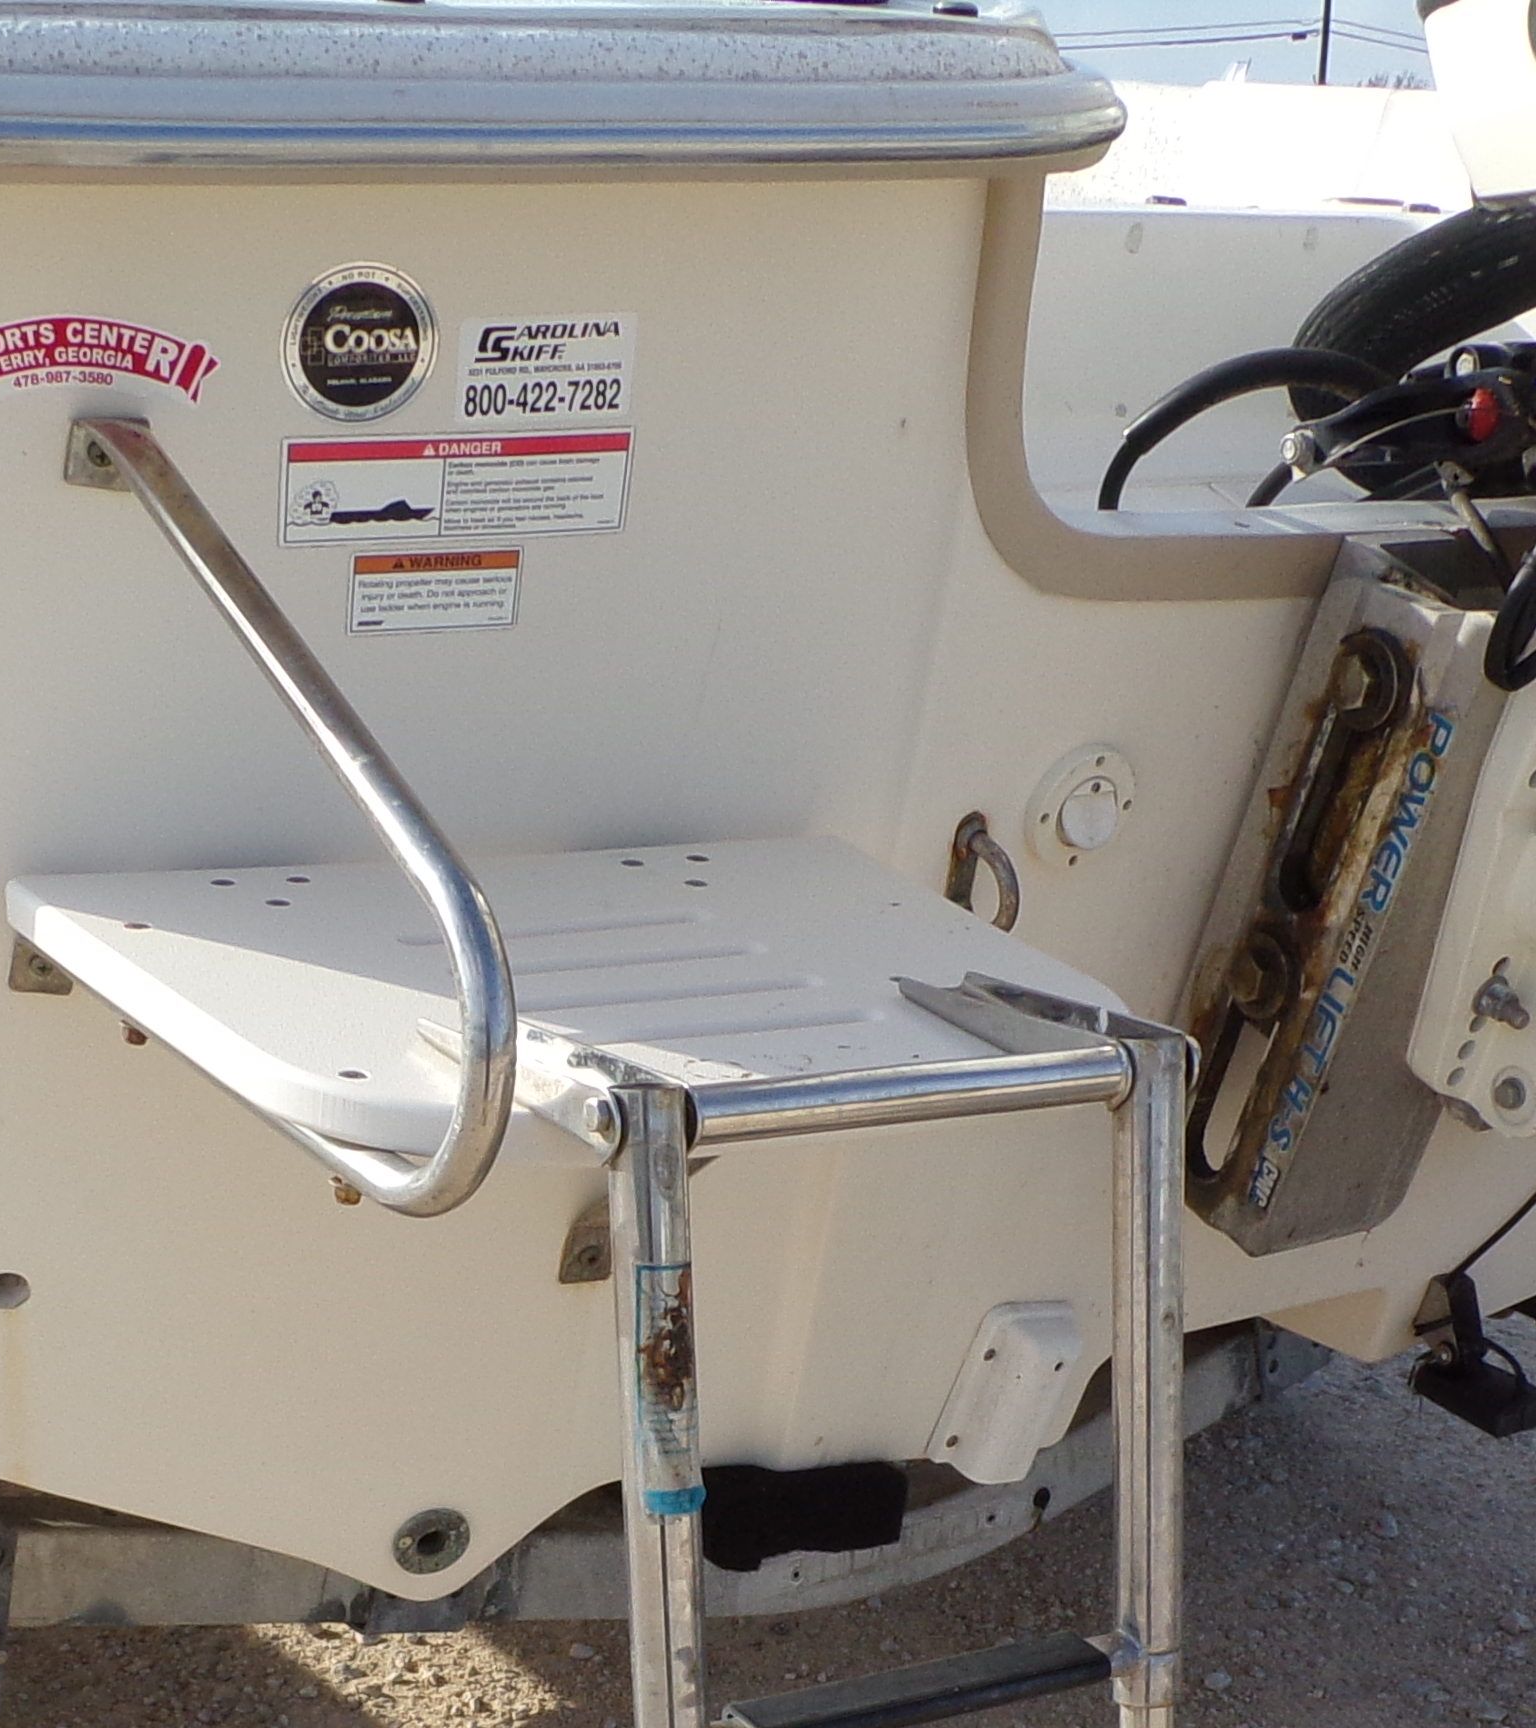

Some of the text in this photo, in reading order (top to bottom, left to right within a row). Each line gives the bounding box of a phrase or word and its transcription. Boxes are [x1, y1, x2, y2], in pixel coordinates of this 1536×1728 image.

[324, 323, 418, 353] COOSA
[474, 335, 566, 363] SKIFF
[477, 321, 620, 353] CAROLINA
[54, 347, 134, 370] GEORGIA
[66, 322, 182, 382] CENTER
[13, 370, 113, 388] 478-987-3580
[464, 378, 622, 417] 800-422-7282
[439, 441, 501, 456] DANGER
[410, 555, 482, 568] WARNING
[426, 590, 439, 598] Do
[1269, 712, 1454, 1152] POWER LIFT H-S
[1352, 921, 1373, 971] HIGH
